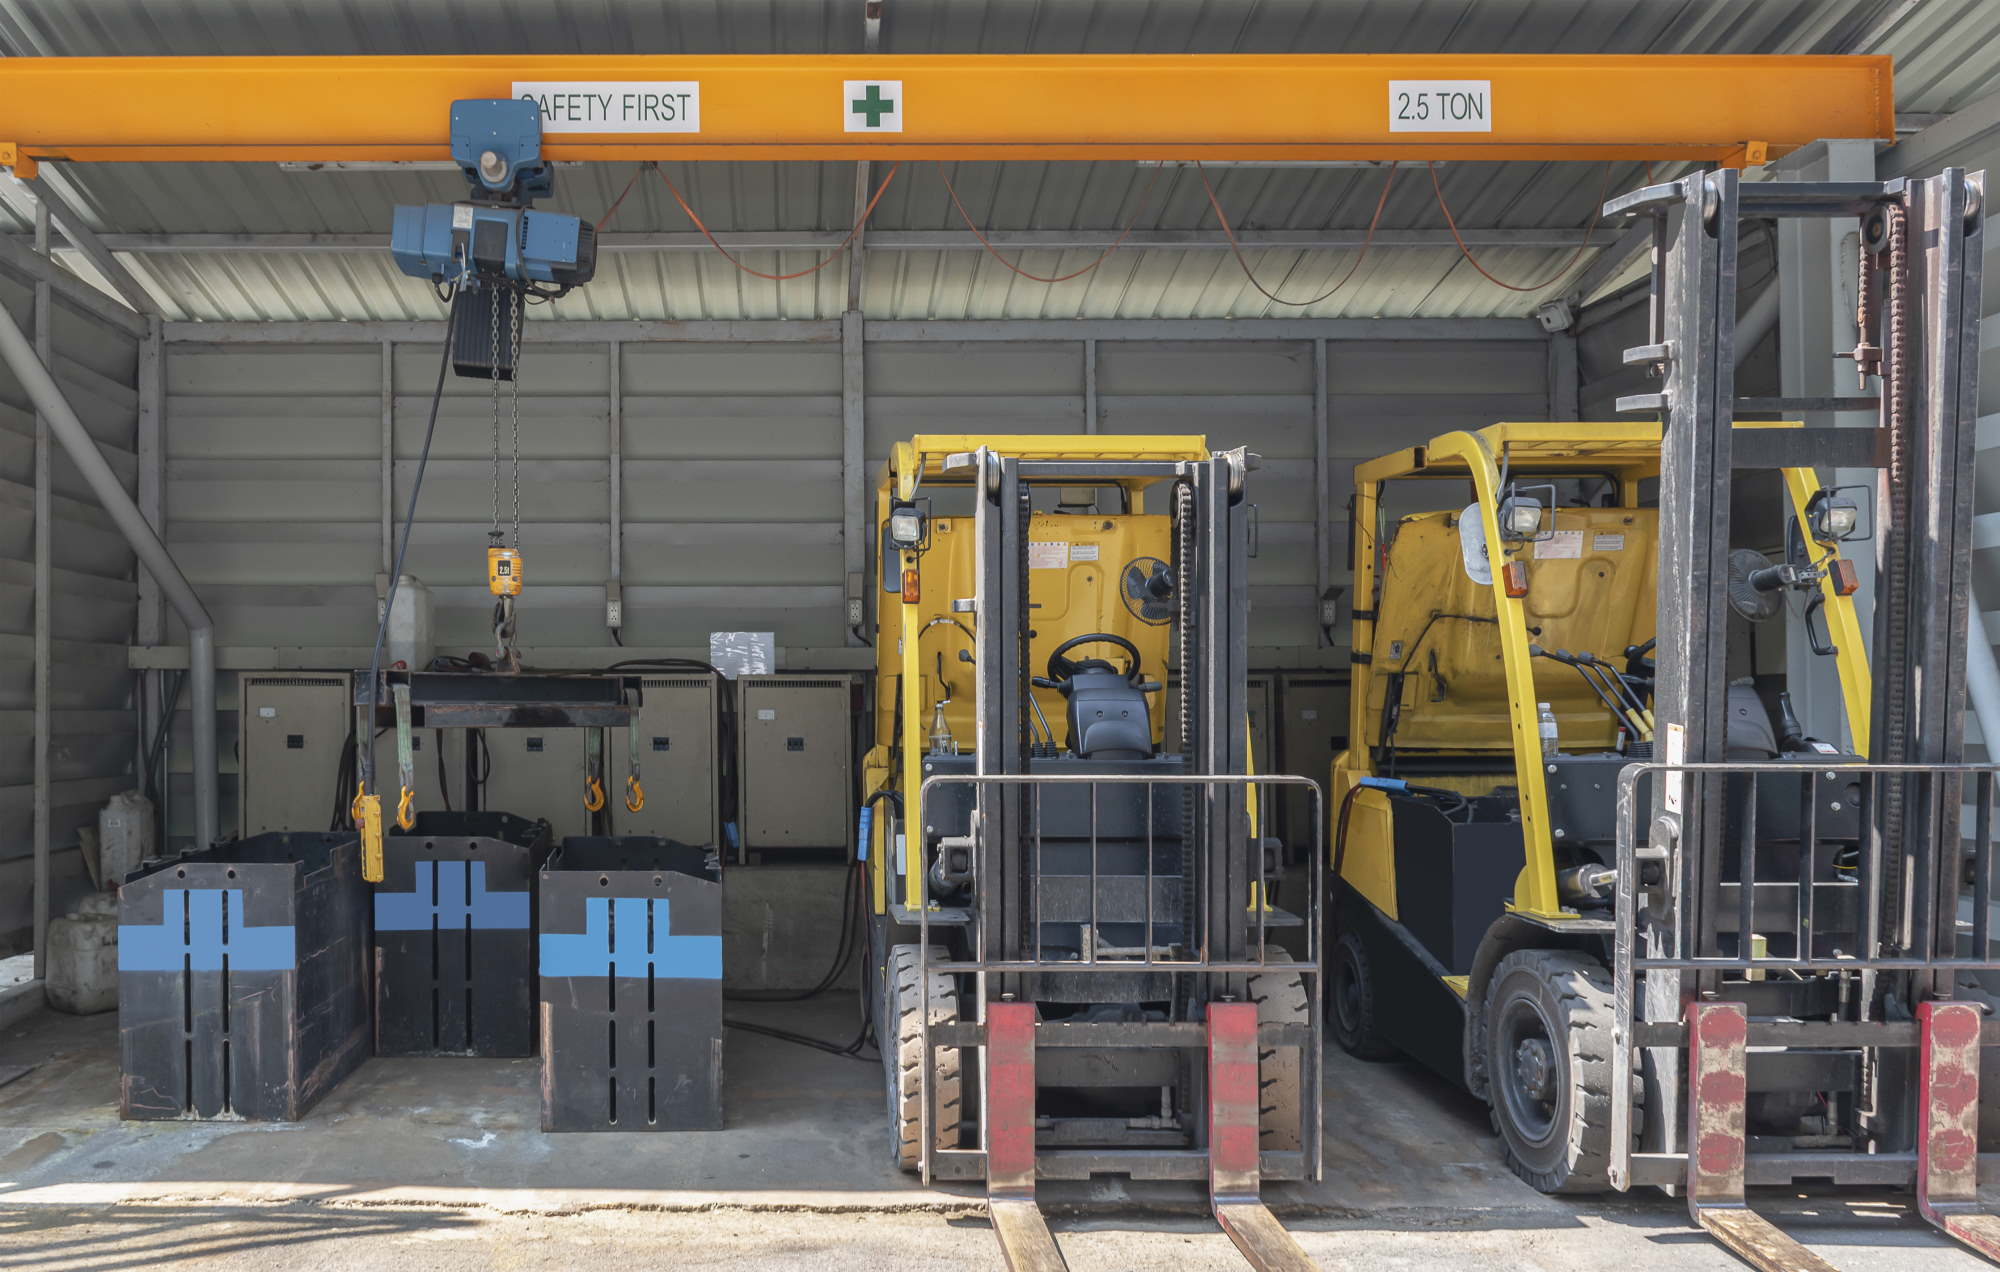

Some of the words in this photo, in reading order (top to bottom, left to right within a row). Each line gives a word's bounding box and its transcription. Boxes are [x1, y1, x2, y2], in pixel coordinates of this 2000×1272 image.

[521, 94, 612, 121] AFETY
[623, 94, 691, 121] FIRST
[1398, 92, 1429, 120] 2.5
[1436, 92, 1483, 120] TON
